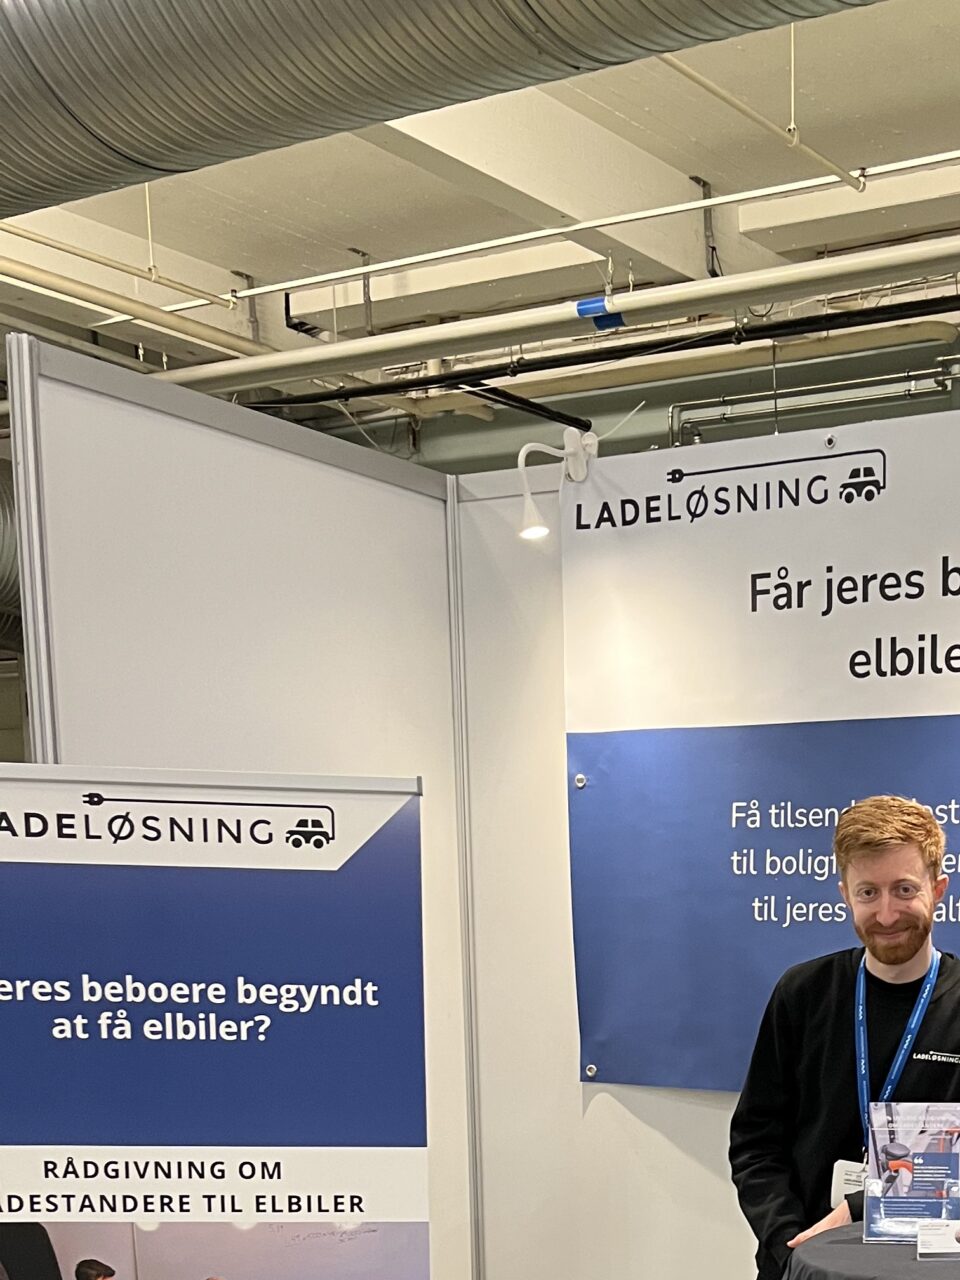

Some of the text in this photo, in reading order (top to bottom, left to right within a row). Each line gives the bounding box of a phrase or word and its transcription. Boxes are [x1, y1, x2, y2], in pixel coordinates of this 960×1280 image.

[574, 474, 829, 530] LADELØSNING
[750, 567, 812, 612] Får
[821, 565, 925, 616] jeres
[731, 799, 761, 828] Få
[768, 799, 855, 828] tilsen
[730, 849, 757, 875] til
[752, 895, 778, 922] til
[782, 895, 847, 928] jeres
[81, 973, 226, 1005] beboere
[237, 976, 379, 1013] begyndt
[52, 1010, 271, 1041] at få elbiler?
[43, 1156, 283, 1180] RÅDGIVNING OM
[0, 1194, 365, 1214] DESTANDERE TIL ELBILER
